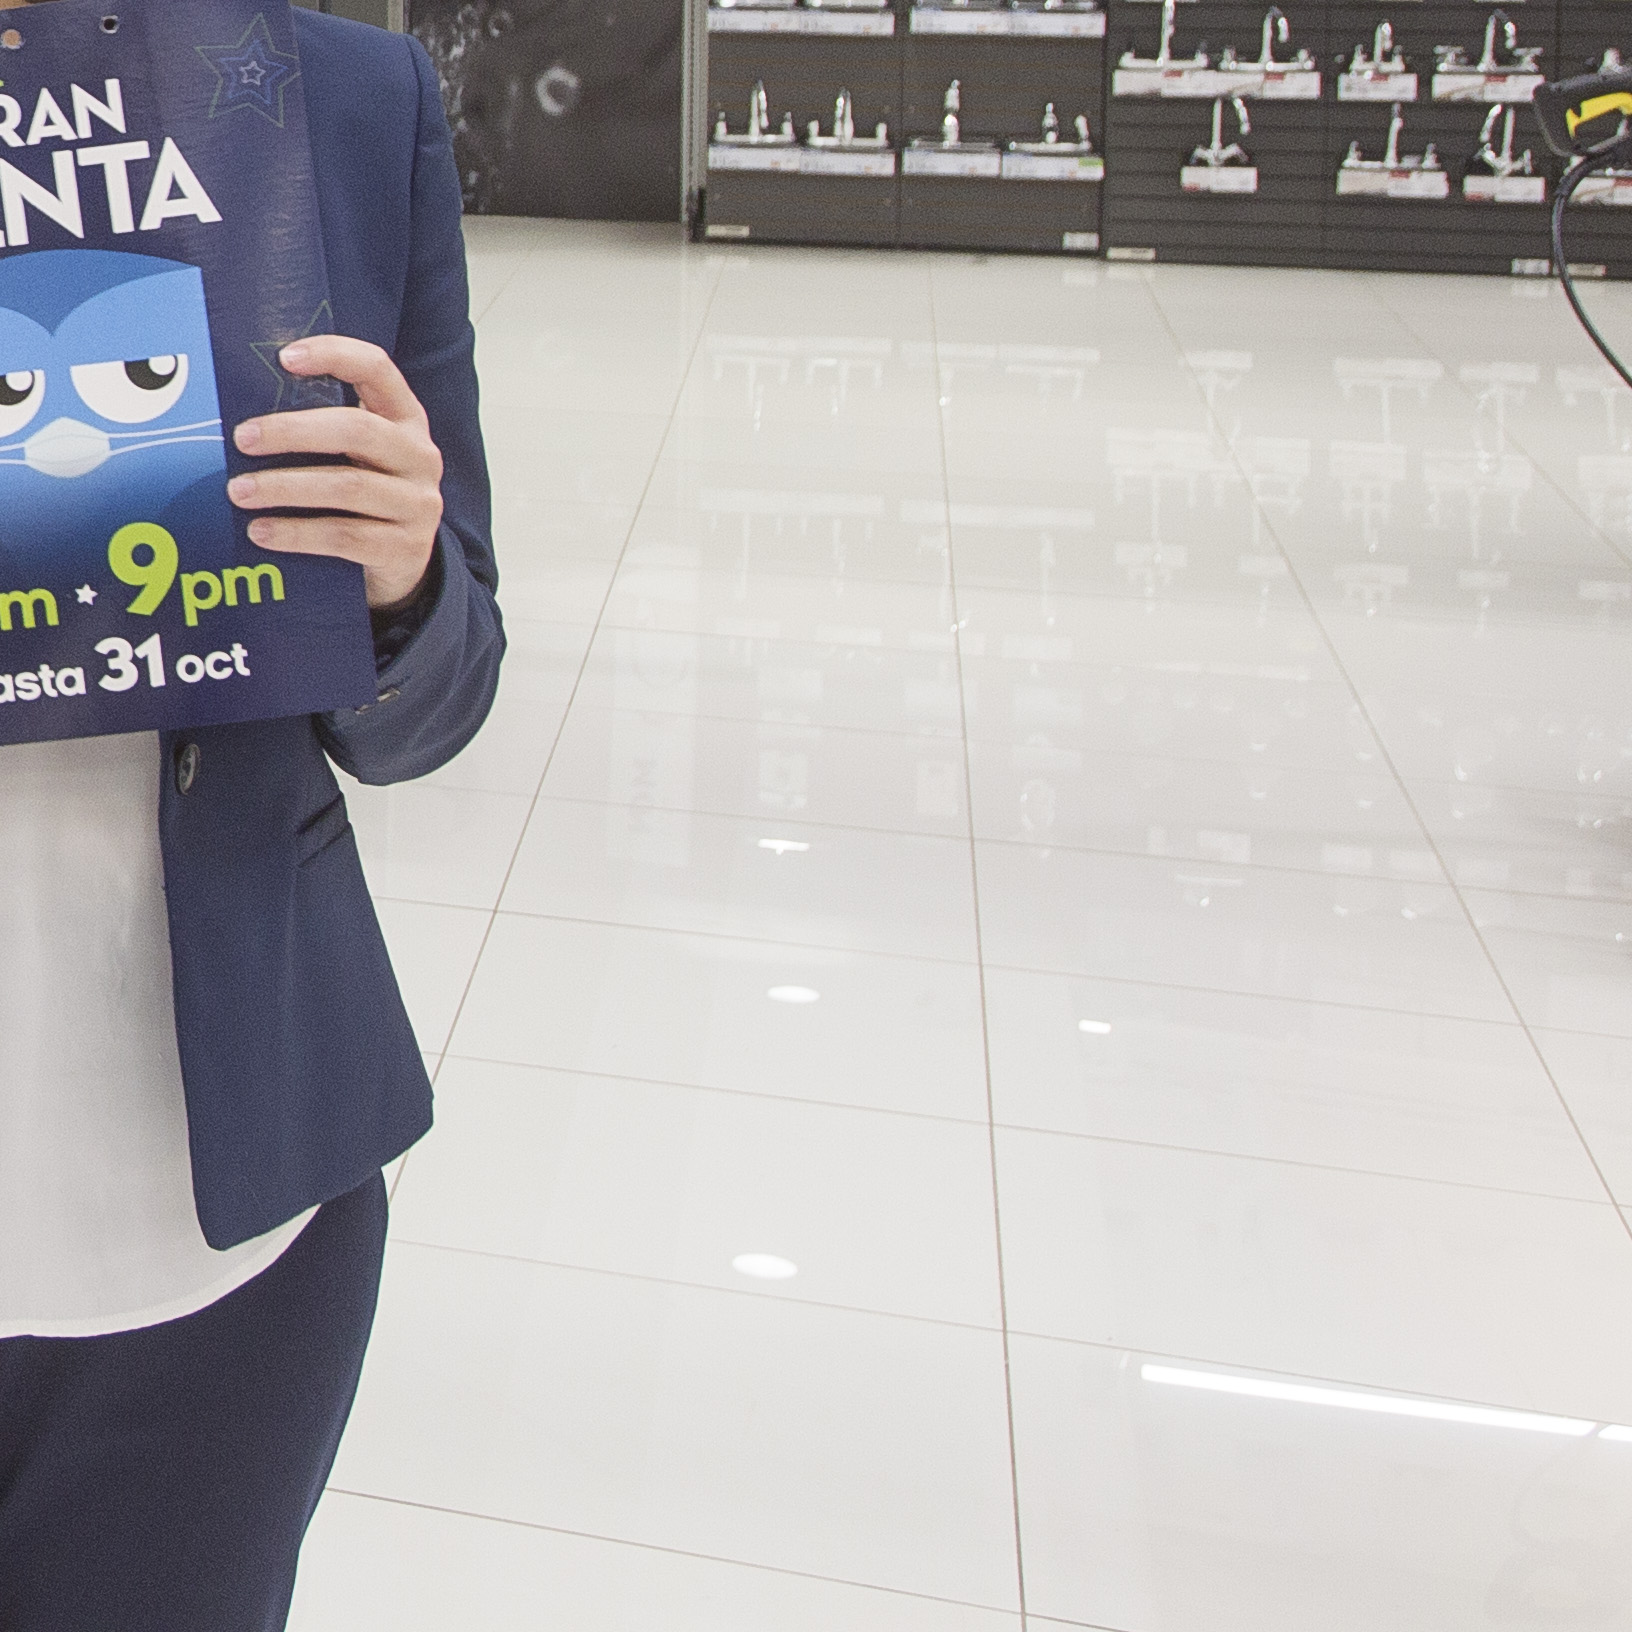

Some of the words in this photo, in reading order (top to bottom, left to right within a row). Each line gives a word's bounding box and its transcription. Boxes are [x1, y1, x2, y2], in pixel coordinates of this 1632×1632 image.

[107, 522, 285, 627] 9pm
[93, 634, 166, 693] 31
[176, 642, 250, 685] oct
